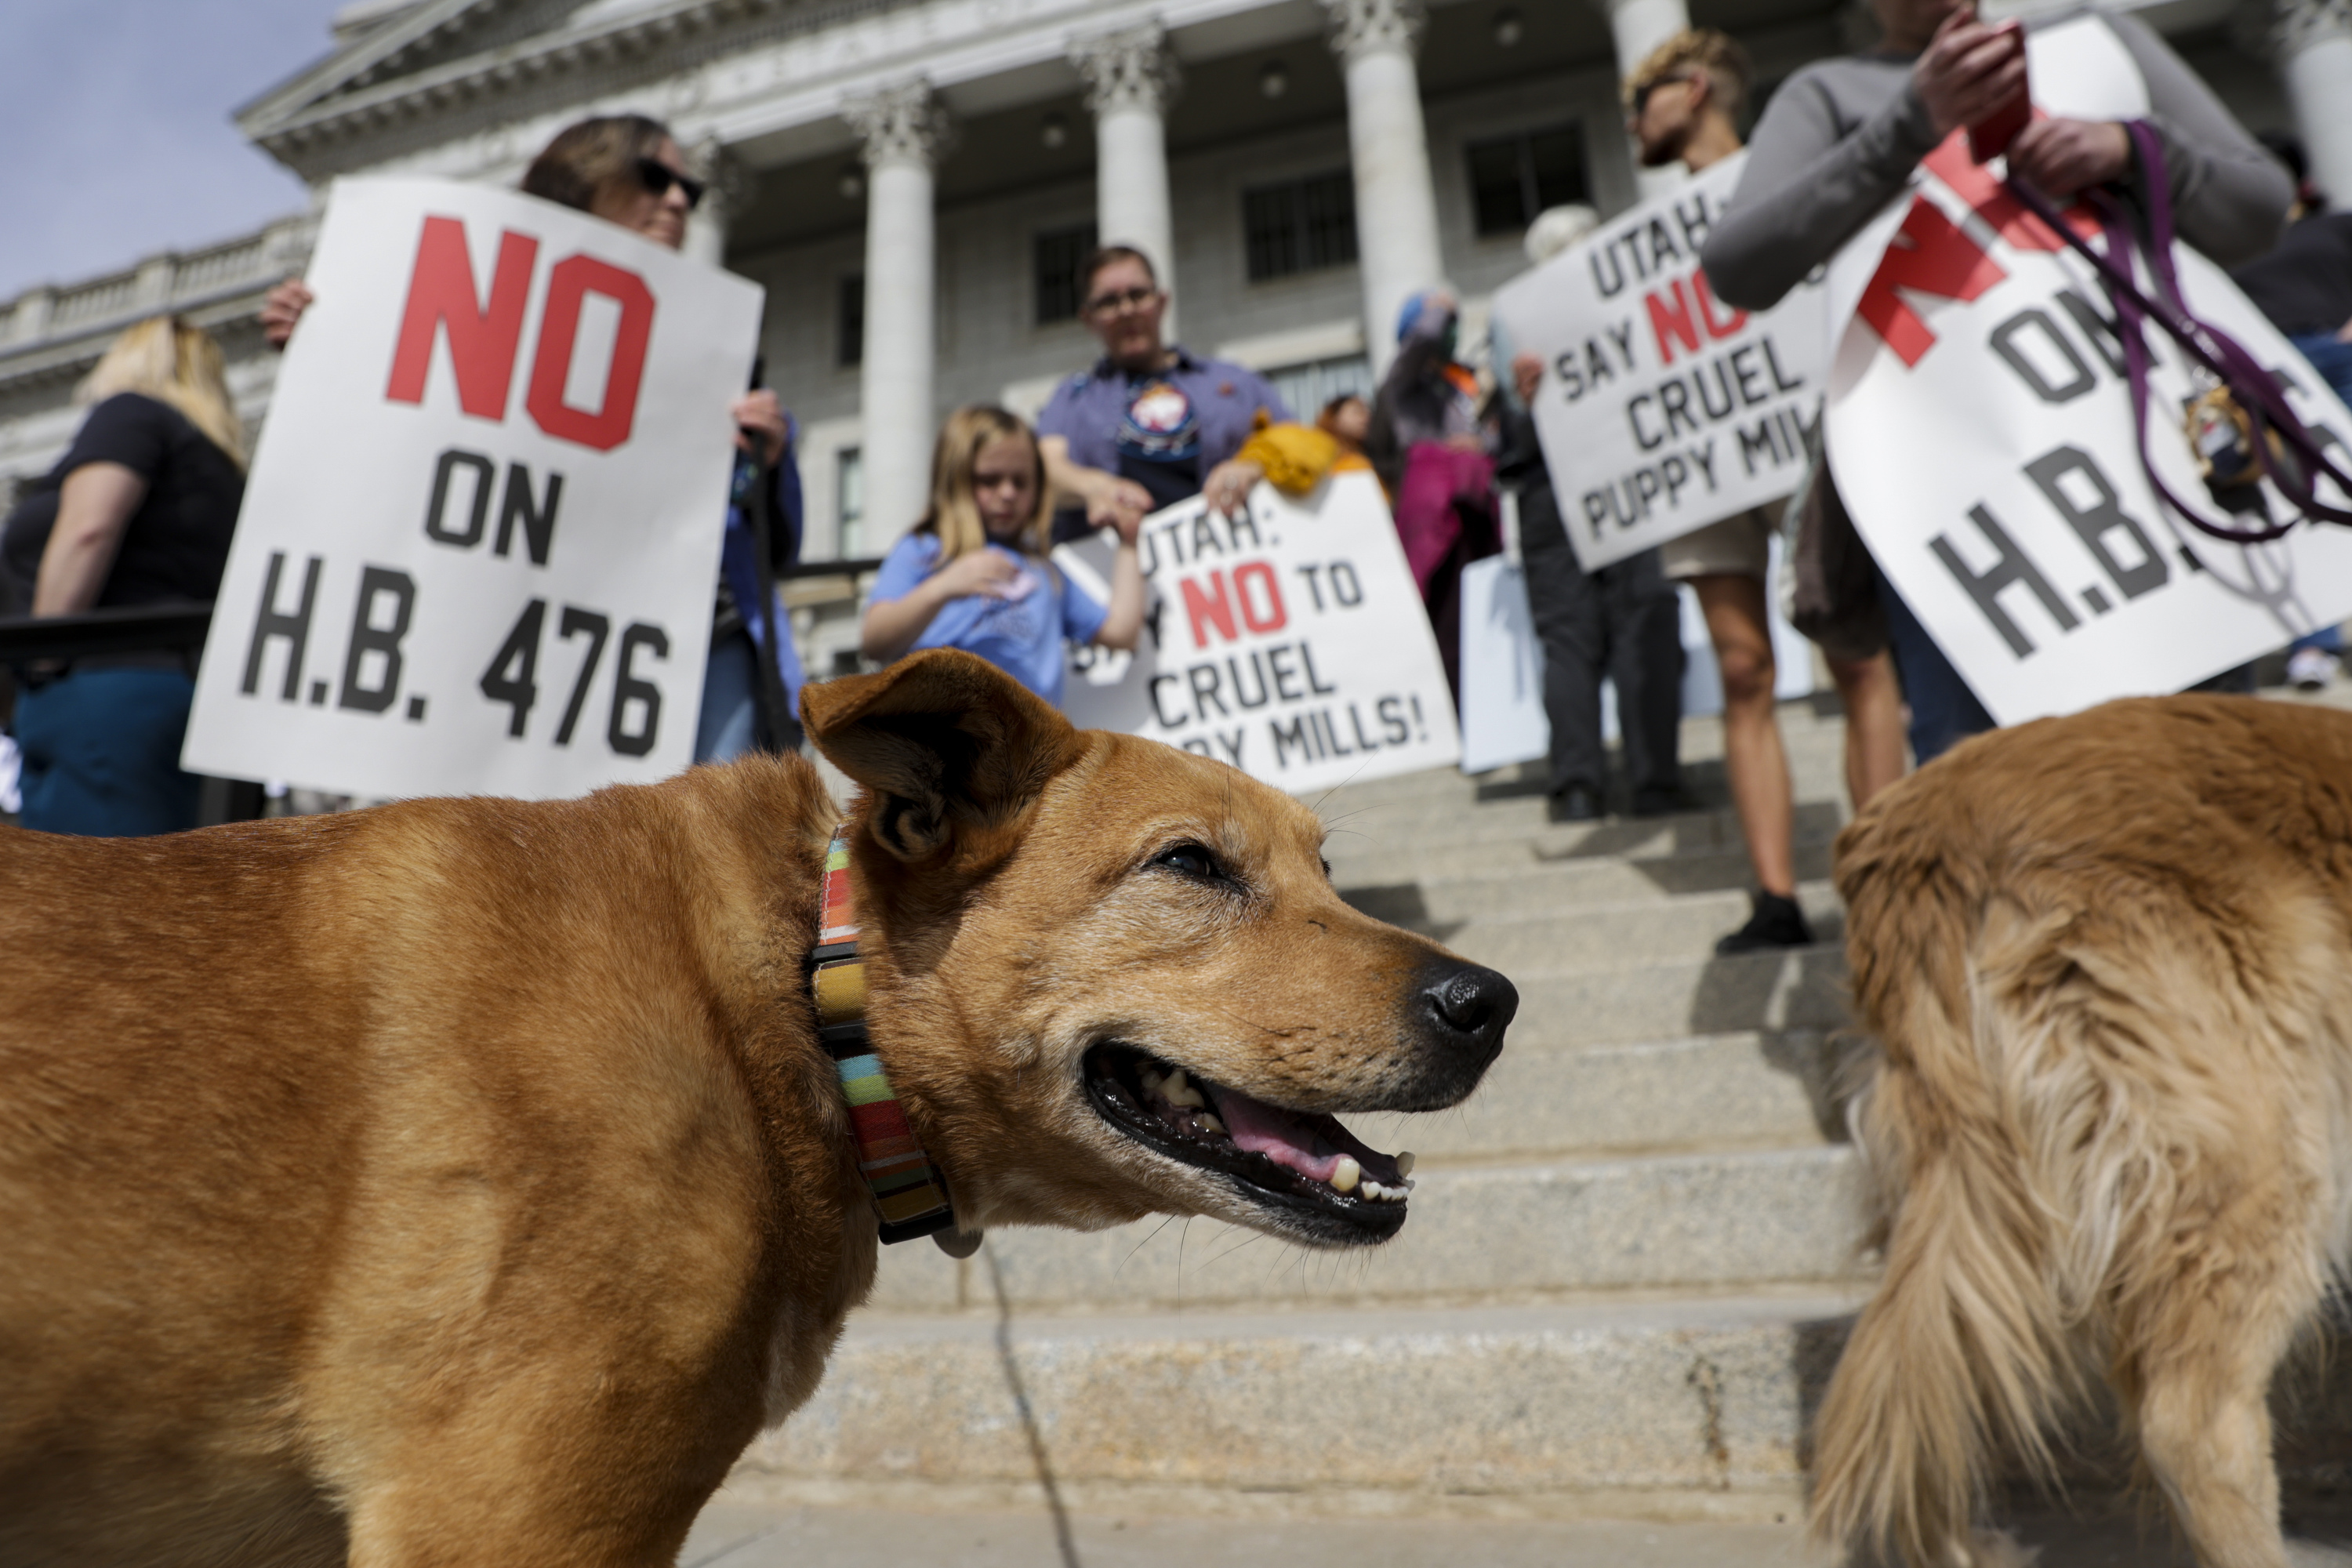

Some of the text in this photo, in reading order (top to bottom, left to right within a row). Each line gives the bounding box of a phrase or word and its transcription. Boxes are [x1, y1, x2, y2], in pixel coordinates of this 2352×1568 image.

[385, 212, 657, 455] NO
[1555, 319, 1635, 403] SAY
[1628, 337, 1806, 453] CRUEL
[424, 446, 563, 568] ON
[1582, 441, 1716, 543] PUPPY
[1180, 560, 1289, 649] NO
[1294, 560, 1366, 612] TO
[1926, 444, 2205, 663] H.B.
[239, 551, 671, 758] H.B. 476
[1149, 639, 1337, 729] CRUEL
[1269, 693, 1429, 769] MILLS!
